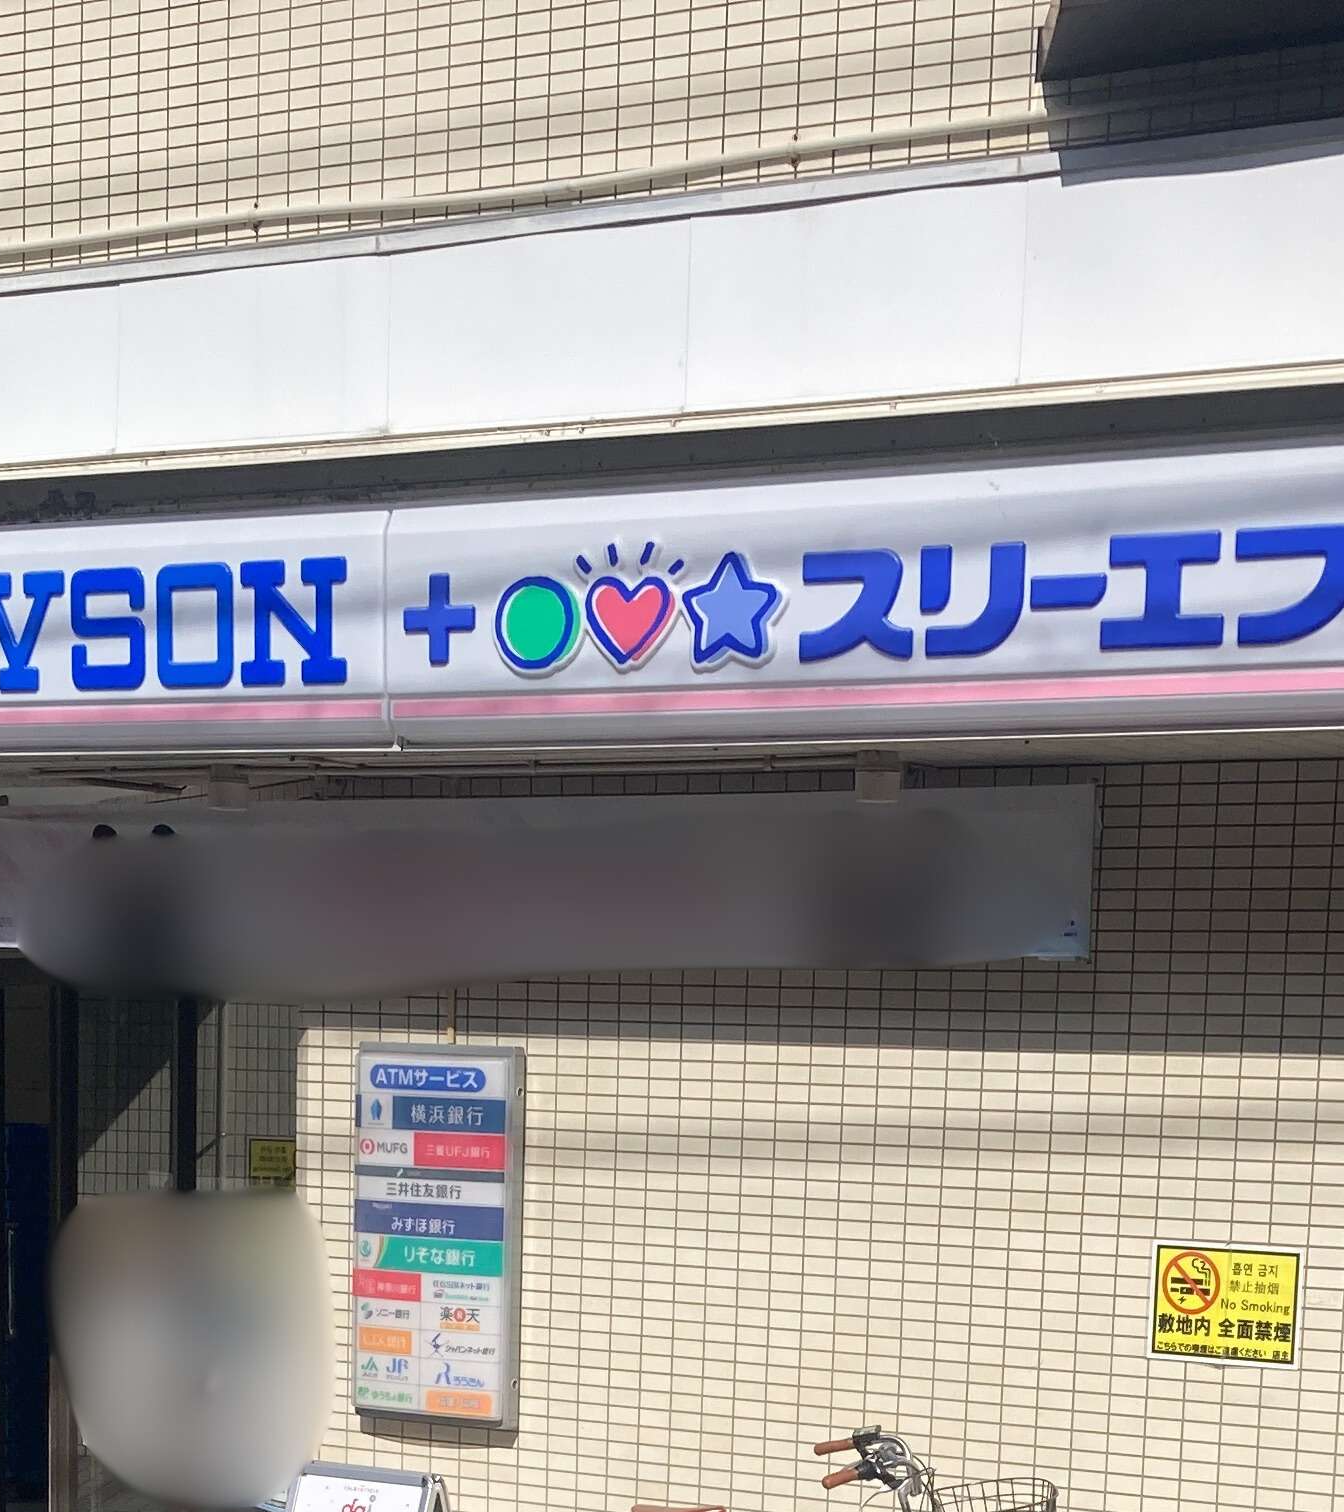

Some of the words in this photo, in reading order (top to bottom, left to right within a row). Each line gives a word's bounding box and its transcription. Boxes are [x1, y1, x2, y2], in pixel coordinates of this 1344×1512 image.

[375, 1068, 478, 1089] ATMサービス
[410, 1103, 484, 1126] 横浜銀行
[376, 1142, 408, 1154] MUFG
[386, 1182, 462, 1199] 三井住友銀行
[391, 1216, 456, 1235] みずほ銀行
[404, 1245, 476, 1268] りそな銀行
[1231, 1262, 1254, 1276] 흡연
[1257, 1264, 1279, 1278] 금지
[1229, 1279, 1280, 1295] 禁止抽烟
[1220, 1298, 1237, 1310] No
[1241, 1299, 1291, 1316] Smoking
[1158, 1313, 1211, 1337] 敷地内
[1217, 1318, 1292, 1343] 全面禁煙
